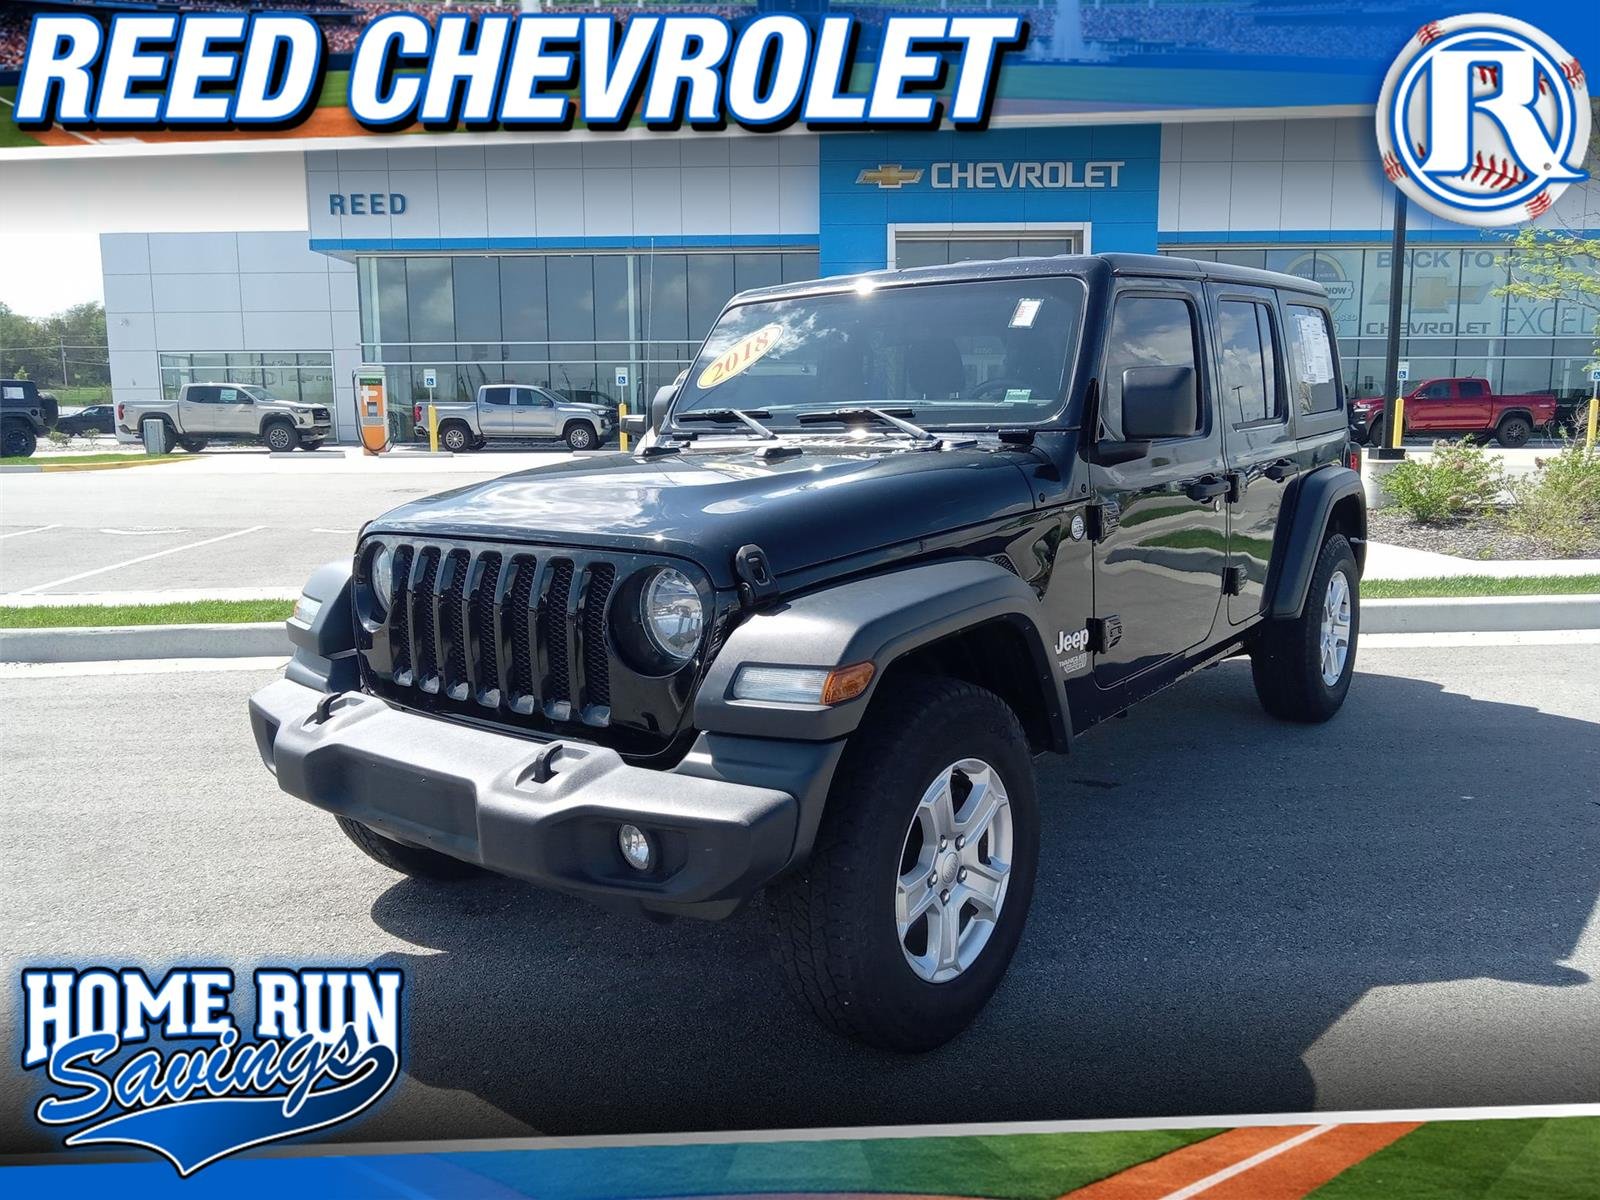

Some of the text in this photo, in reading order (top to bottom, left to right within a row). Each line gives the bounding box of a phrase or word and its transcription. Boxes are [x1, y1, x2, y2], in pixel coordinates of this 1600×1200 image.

[931, 161, 1125, 188] CHEVROLET
[329, 193, 406, 215] REED
[1377, 251, 1450, 268] BCK
[1463, 251, 1494, 268] TO
[712, 332, 769, 383] 2018
[1055, 628, 1089, 654] Jeep
